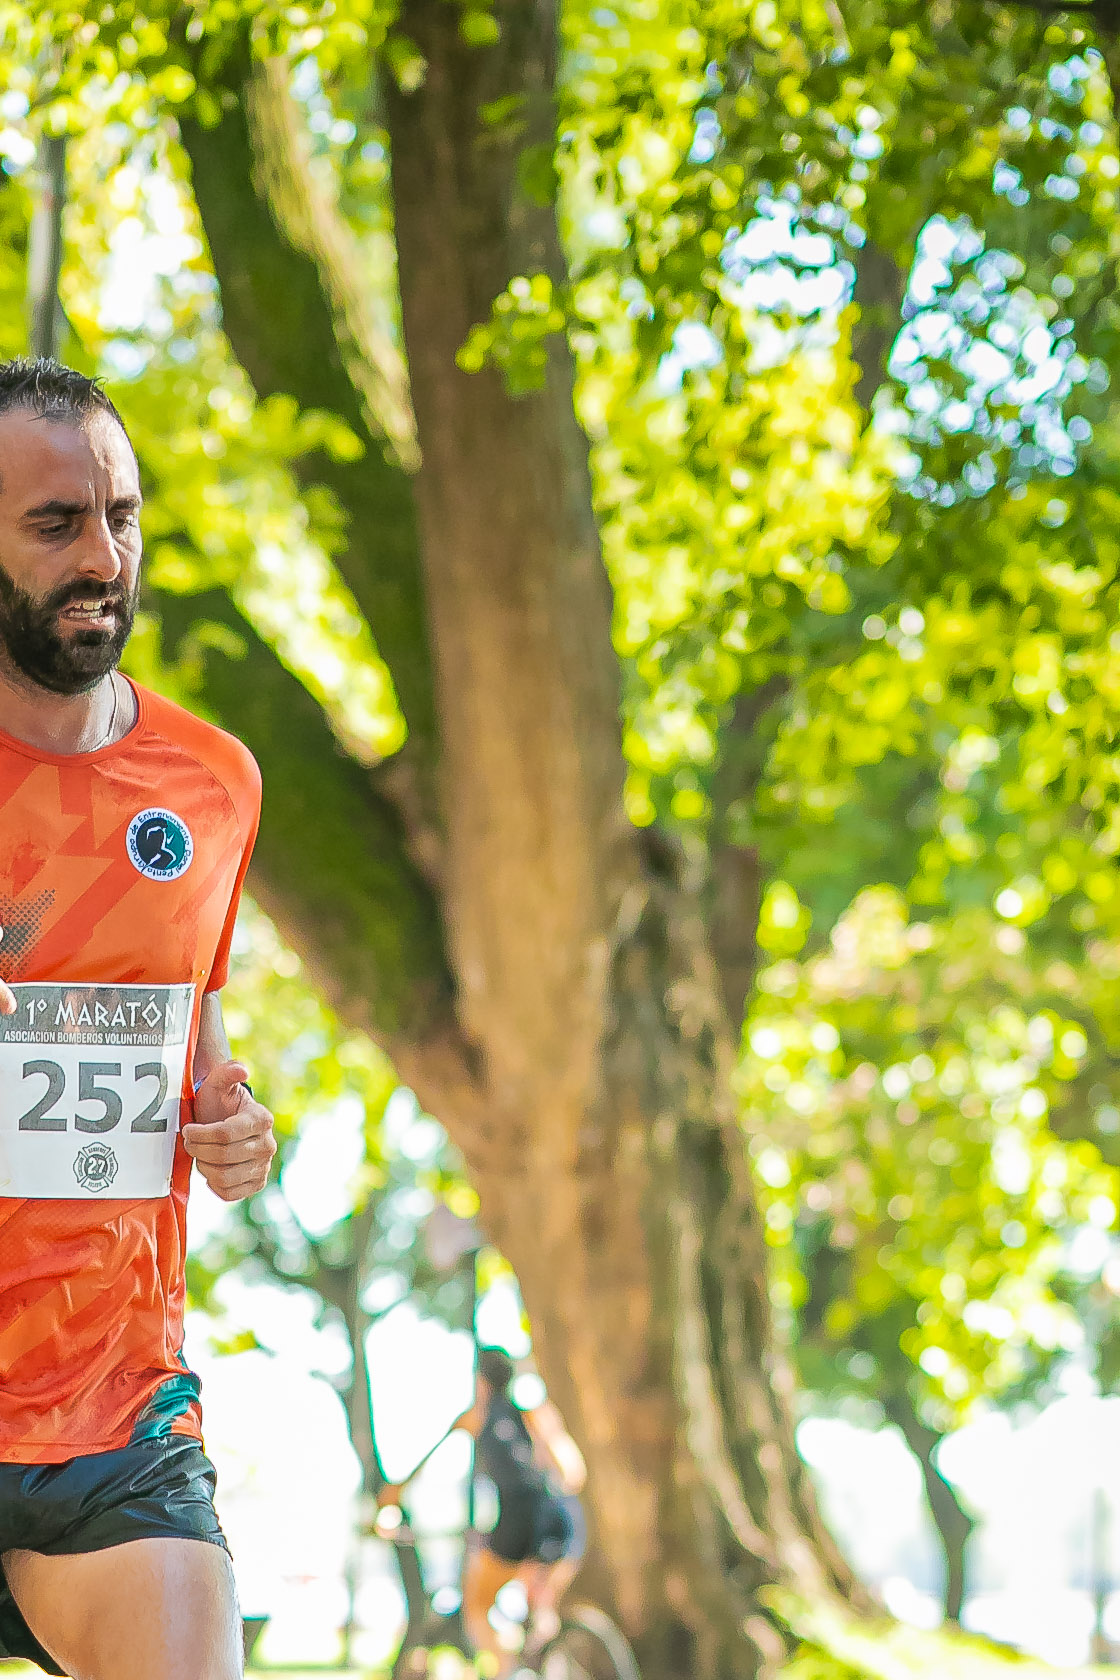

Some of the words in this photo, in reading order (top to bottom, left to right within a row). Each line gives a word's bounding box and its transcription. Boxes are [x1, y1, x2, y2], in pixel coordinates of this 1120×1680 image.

[54, 994, 177, 1028] MARATÓN
[4, 1028, 55, 1043] ASOCIACIÓN
[58, 1031, 103, 1044] BOMBEROS
[105, 1032, 162, 1045] VOLUNTARIOS
[19, 1059, 168, 1133] 252
[88, 1157, 105, 1175] 27
